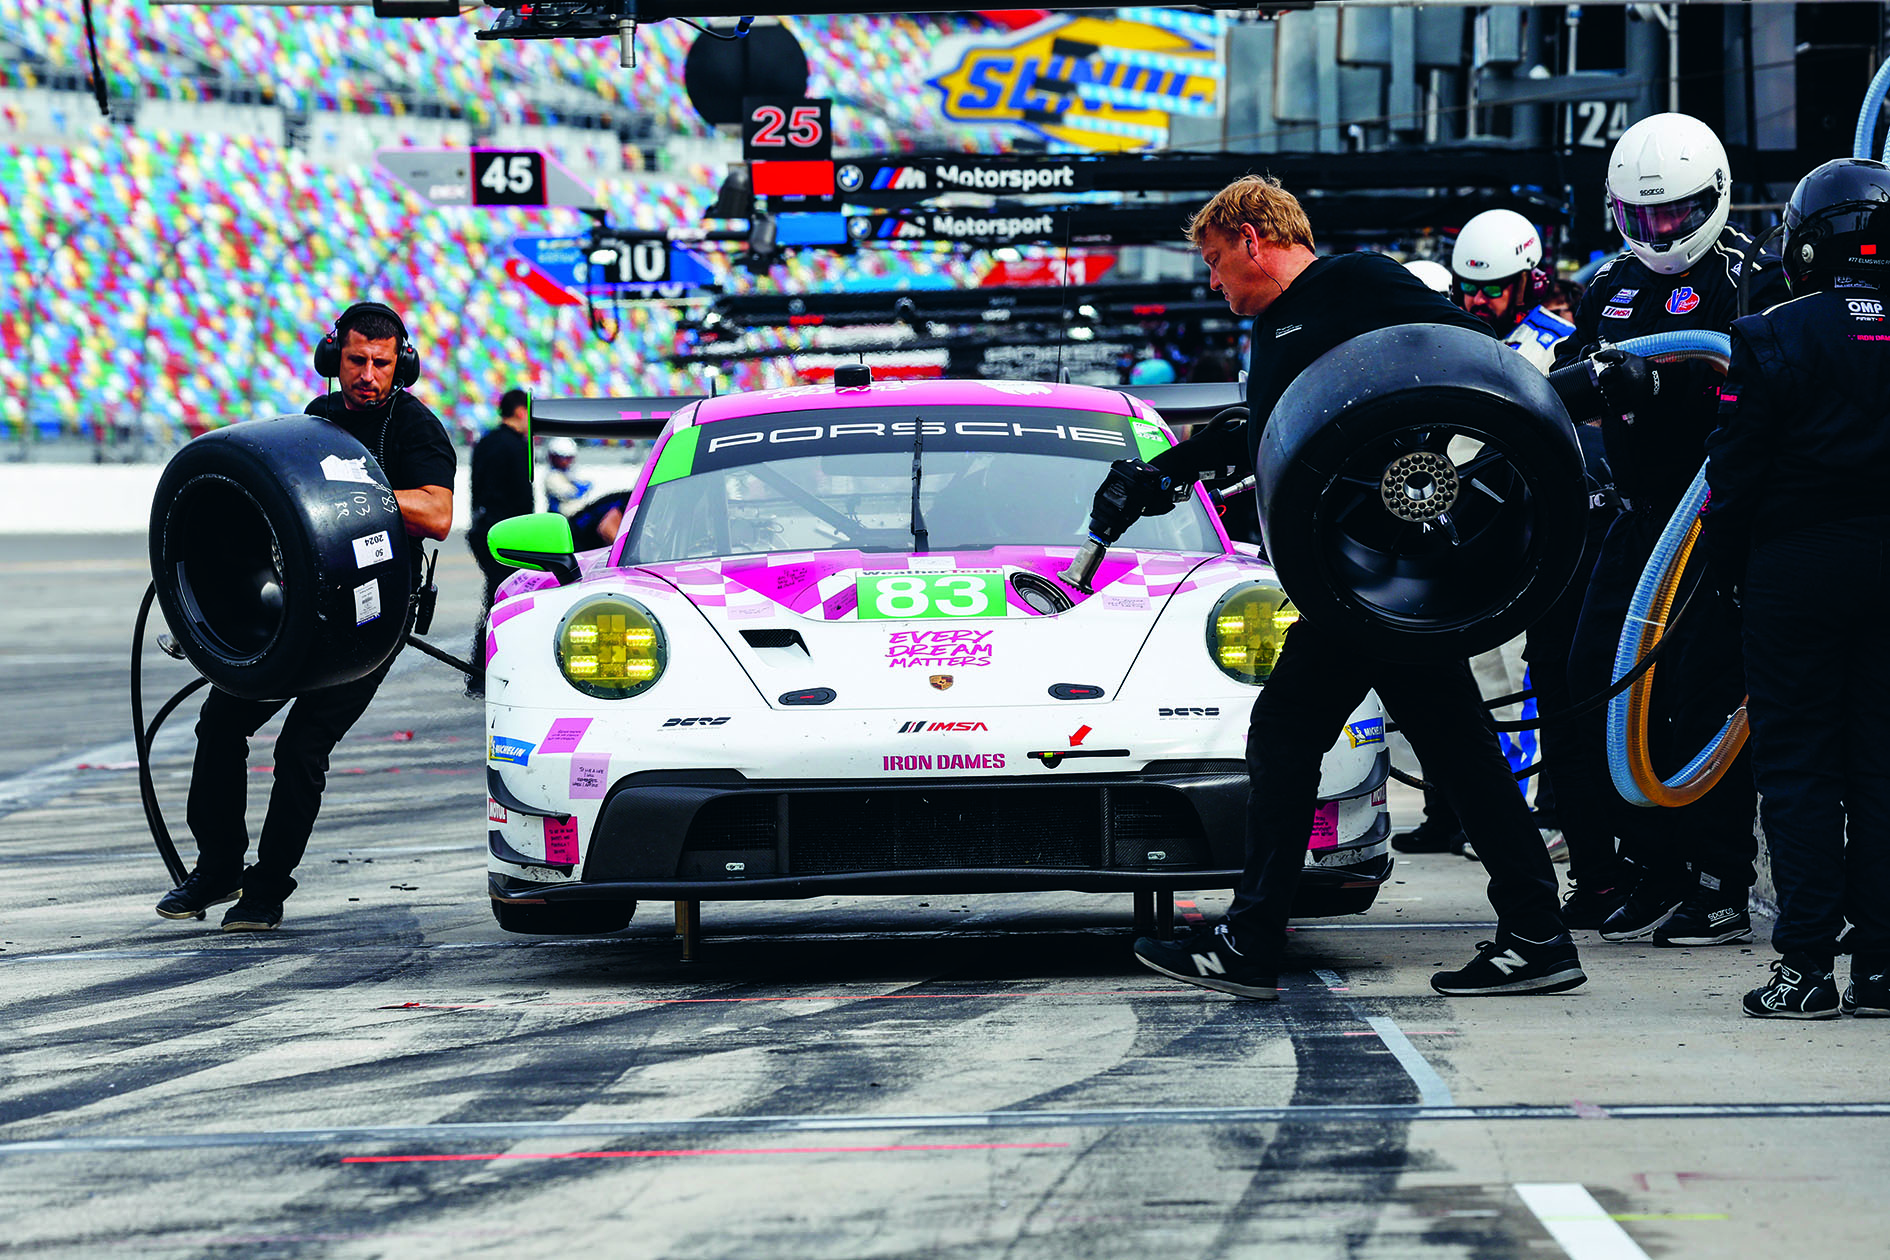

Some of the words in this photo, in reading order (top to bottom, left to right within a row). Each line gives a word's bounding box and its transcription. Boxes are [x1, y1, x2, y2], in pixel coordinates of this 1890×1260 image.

[750, 105, 823, 148] 25
[1578, 101, 1627, 148] 24
[481, 156, 534, 194] 45
[936, 165, 1074, 192] Motorsport
[1640, 188, 1664, 196] sparco
[933, 214, 1053, 239] Motorsport
[619, 243, 666, 283] 10
[1670, 286, 1693, 313] VP
[1848, 301, 1883, 313] OMP
[708, 421, 1127, 454] PORSCHE
[350, 491, 371, 516] 103
[364, 534, 385, 547] 2024
[876, 576, 989, 618] 83
[889, 629, 994, 644] EVERY
[884, 643, 993, 657] DREAM
[888, 656, 992, 668] MATTERS
[926, 721, 989, 732] IMSA
[495, 744, 527, 758] MICHELIN
[882, 754, 932, 771] IRON
[937, 753, 1006, 770] DAMES
[1707, 907, 1734, 921] sparco
[1191, 951, 1226, 976] N
[1489, 948, 1529, 976] N
